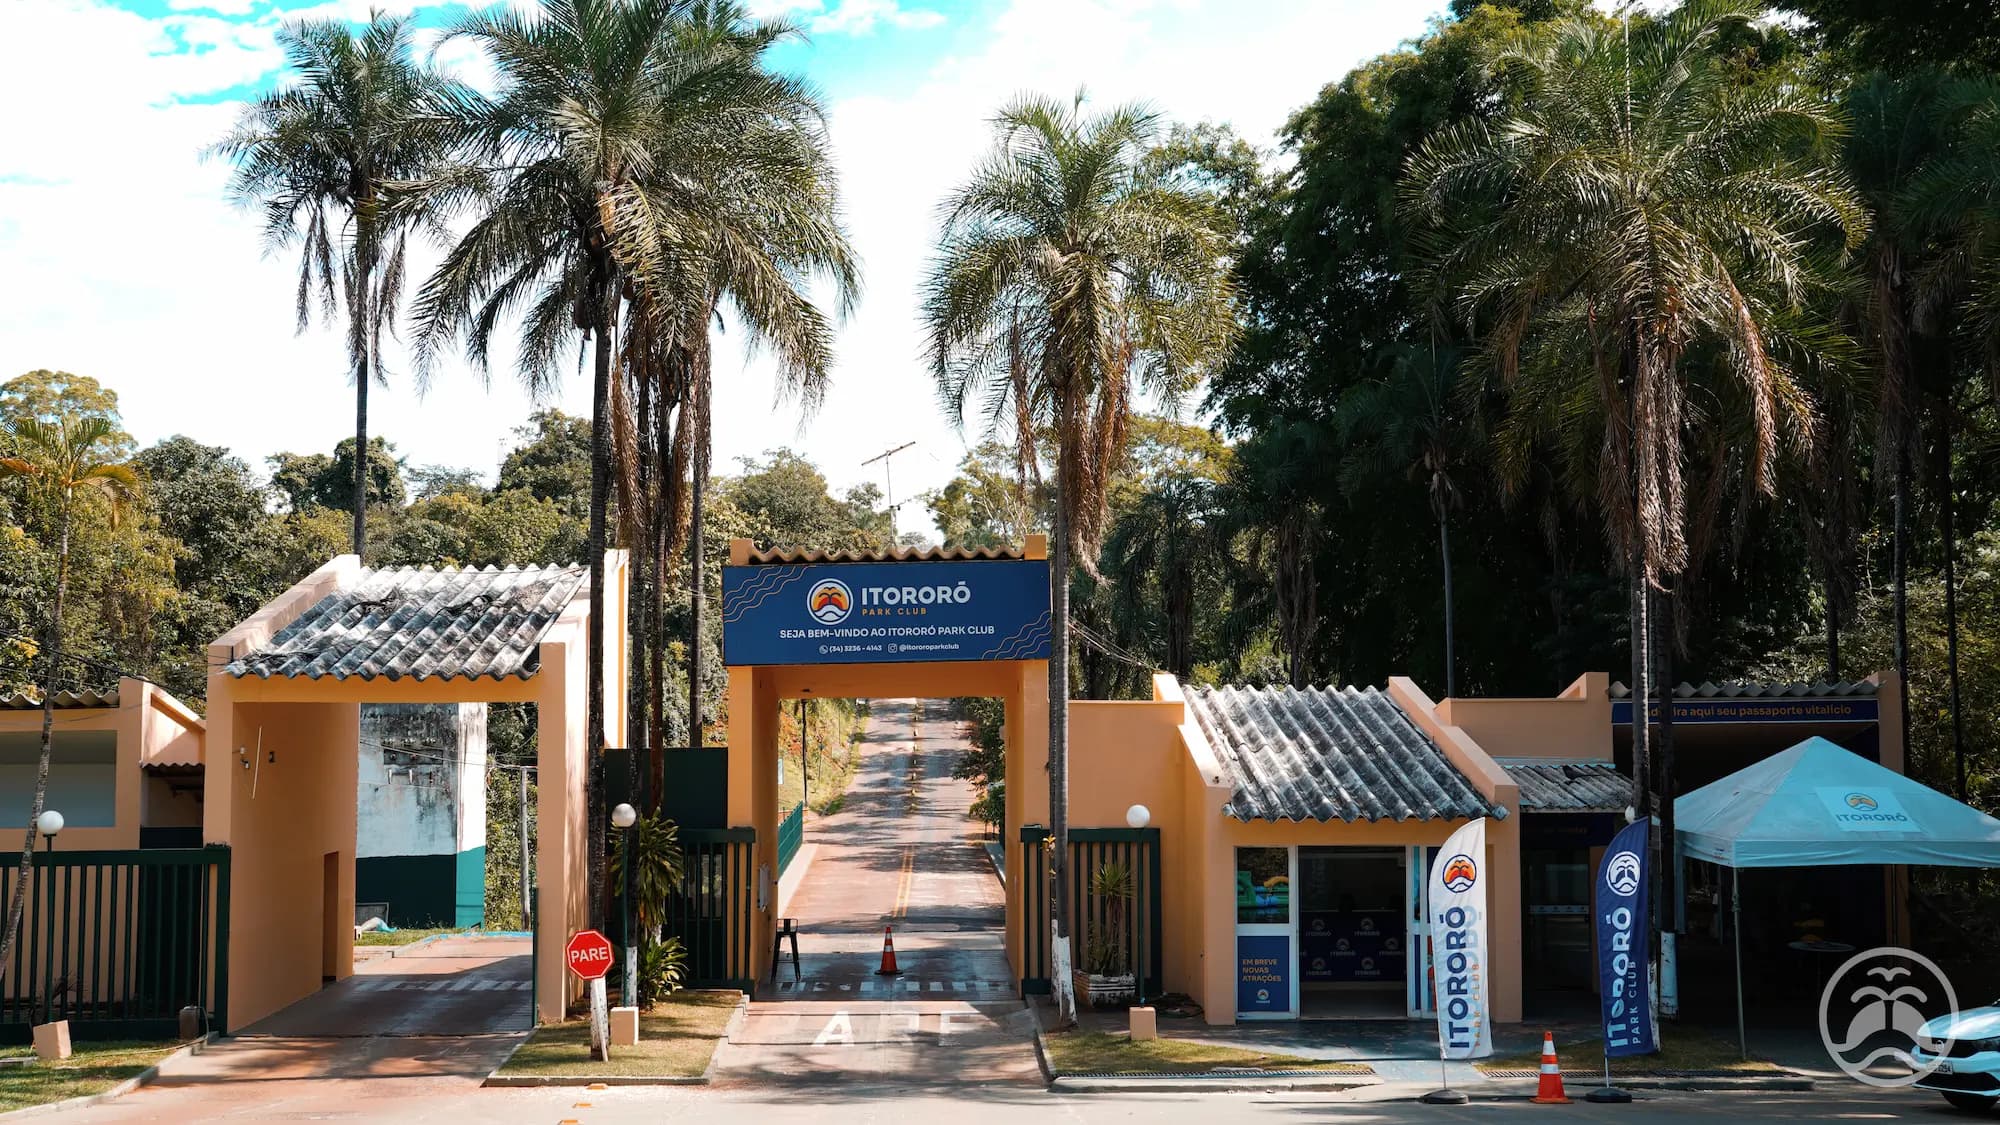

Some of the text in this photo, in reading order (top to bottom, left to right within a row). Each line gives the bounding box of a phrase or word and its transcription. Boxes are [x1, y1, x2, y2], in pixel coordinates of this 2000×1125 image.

[861, 581, 971, 606] ITORORÓ
[862, 607, 927, 616] PARK CLUB
[780, 625, 995, 639] SEJA BEM-VINDO AO ITORORÓ PARK CLUB
[1690, 705, 1714, 718] aqui
[1717, 707, 1737, 717] seu
[1739, 705, 1803, 718] passaporte
[1805, 703, 1851, 715] vitalício
[570, 946, 609, 963] PARE
[1439, 906, 1470, 1048] ITORORÓ
[1471, 963, 1481, 1001] CLUB
[1628, 961, 1640, 1044] PARK CLUB
